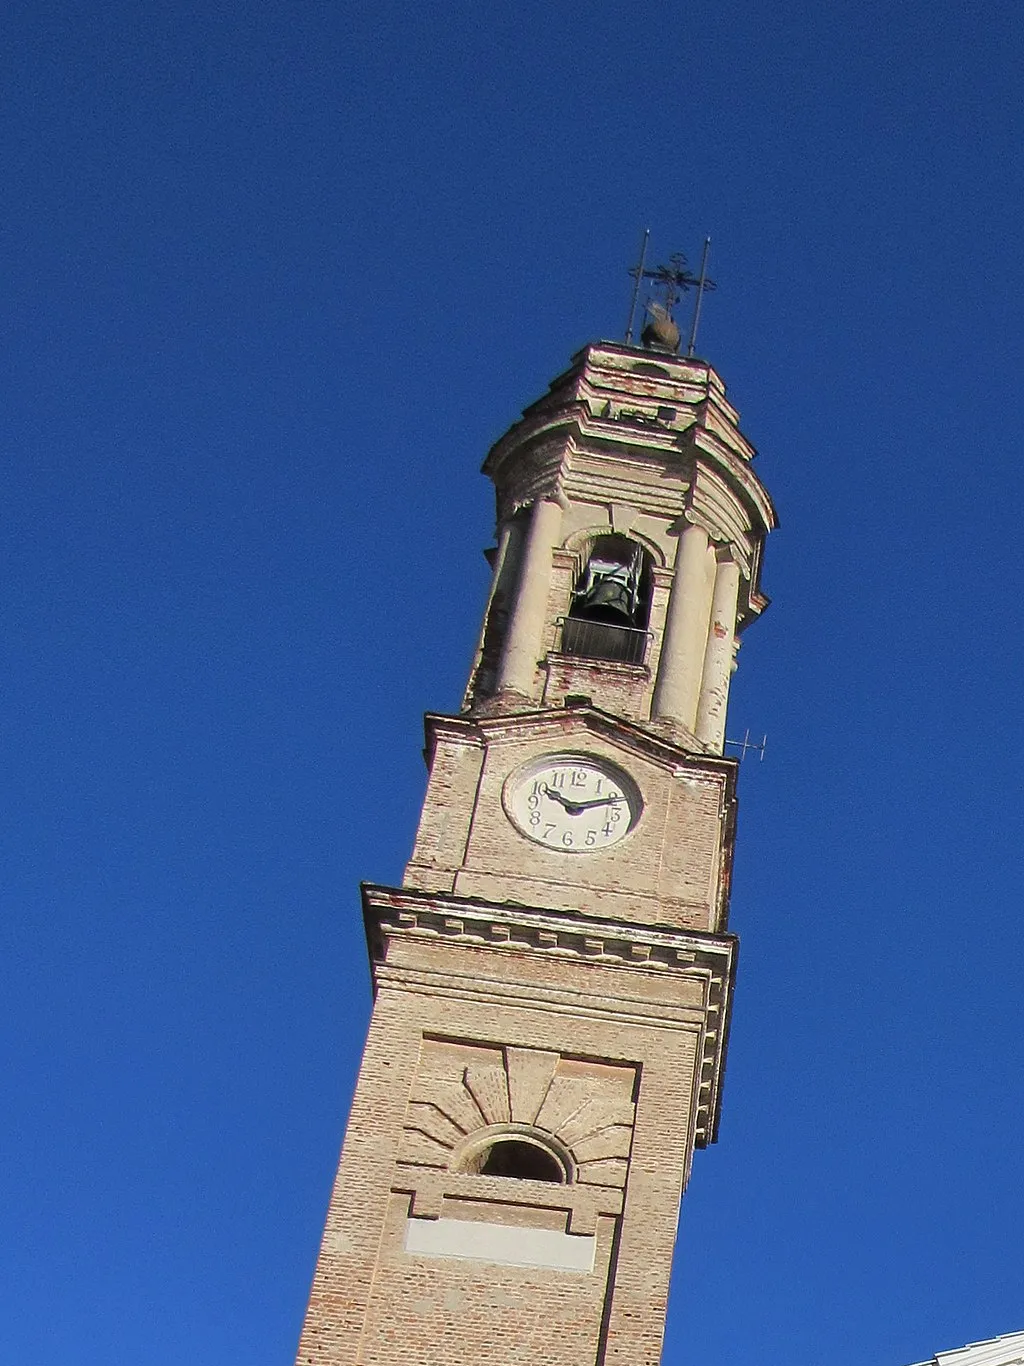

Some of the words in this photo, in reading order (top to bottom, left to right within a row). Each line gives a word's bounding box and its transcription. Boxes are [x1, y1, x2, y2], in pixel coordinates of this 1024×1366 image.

[552, 772, 565, 788] 11
[572, 771, 587, 787] 12
[596, 779, 602, 794] 1
[533, 781, 549, 796] 10
[528, 795, 539, 810] 9
[529, 811, 541, 825] 8
[611, 807, 622, 822] 3
[542, 823, 556, 838] 7
[601, 822, 613, 837] 4
[562, 831, 573, 846] 6
[585, 831, 597, 846] 5
